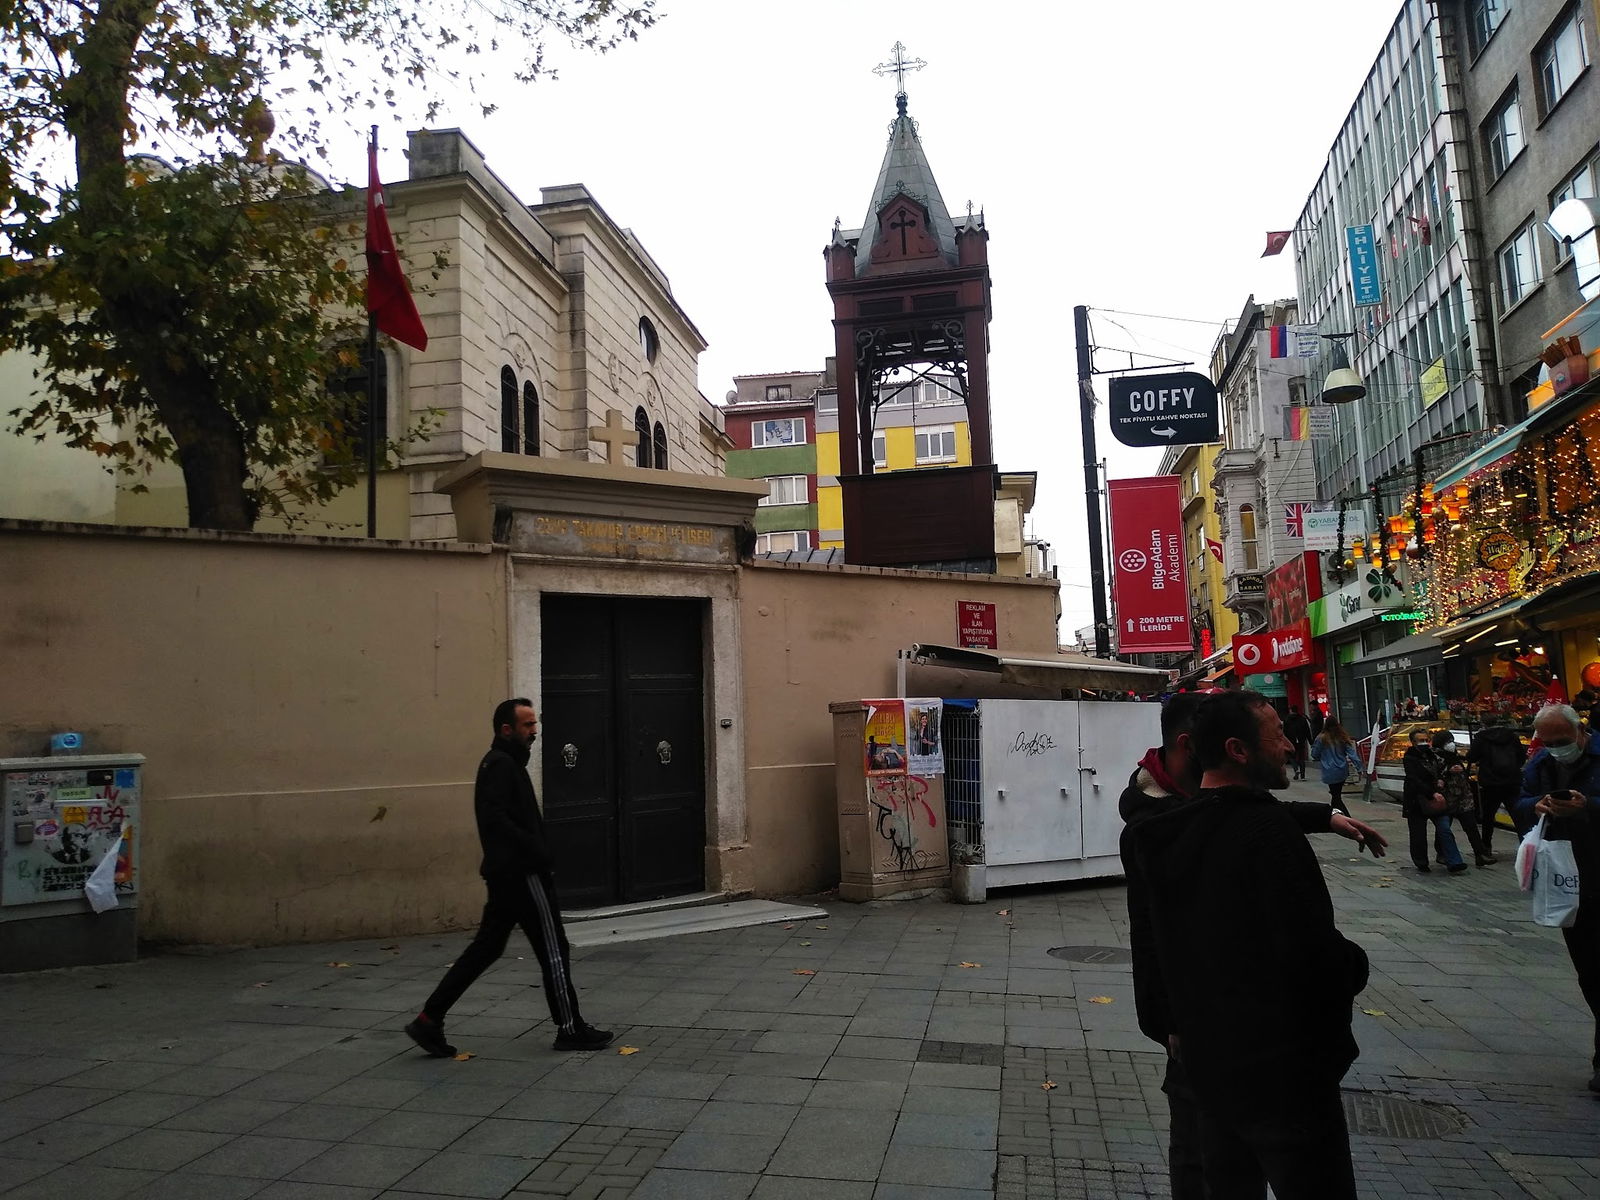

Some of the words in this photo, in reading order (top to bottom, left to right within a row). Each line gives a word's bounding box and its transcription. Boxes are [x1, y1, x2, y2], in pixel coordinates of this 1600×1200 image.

[1129, 387, 1195, 412] COFFY
[1150, 529, 1167, 590] BilgeAdam
[1166, 534, 1181, 582] Akademi
[965, 604, 986, 612] REKLAM
[1139, 616, 1155, 624] 200
[1156, 615, 1185, 623] METRE
[1139, 623, 1172, 632] İLERİDE
